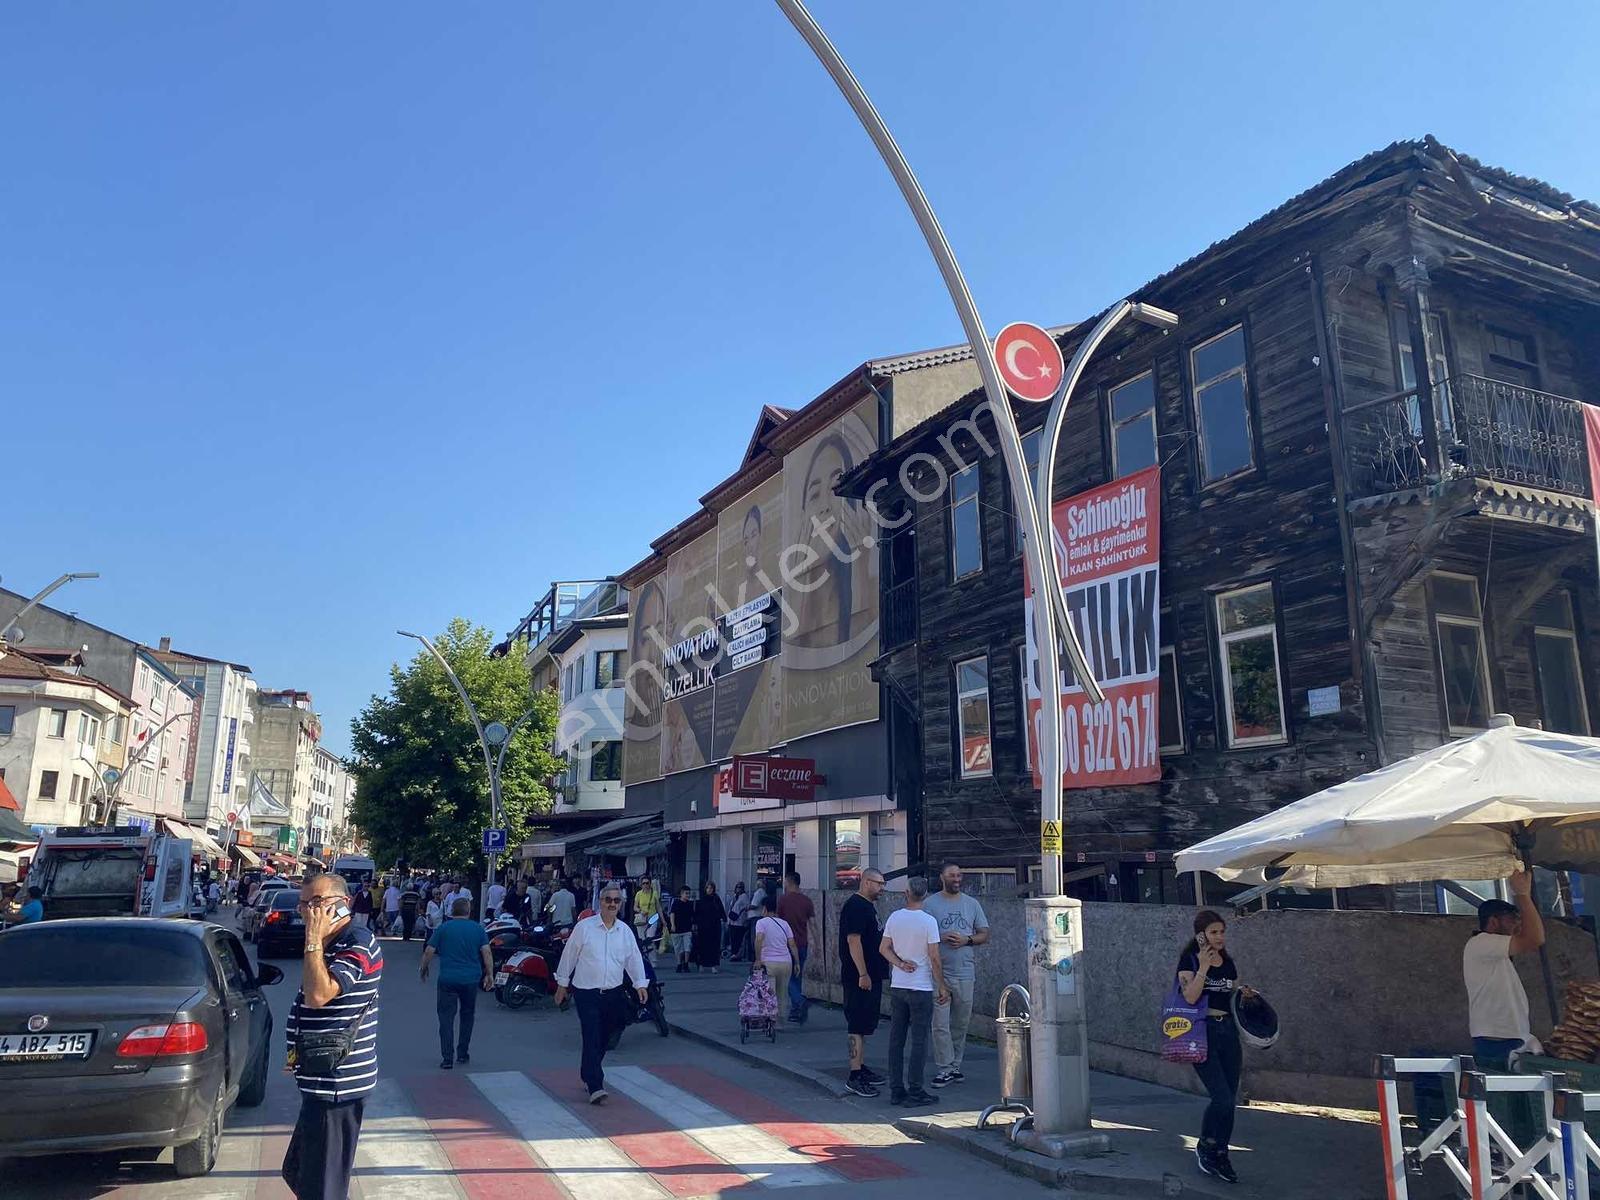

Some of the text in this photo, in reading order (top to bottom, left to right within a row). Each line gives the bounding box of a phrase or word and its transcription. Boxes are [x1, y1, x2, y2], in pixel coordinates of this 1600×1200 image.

[1068, 484, 1146, 545] Şahinoğlu
[1070, 522, 1147, 559] emlak & gayrimenkul
[1070, 560, 1093, 575] KAAN
[662, 625, 719, 669] INNOVATION
[1082, 698, 1116, 774] 322
[770, 767, 811, 782] eczane
[488, 831, 501, 846] P
[1164, 1019, 1188, 1033] gratis
[0, 1035, 86, 1053] 4 ABZ 515
